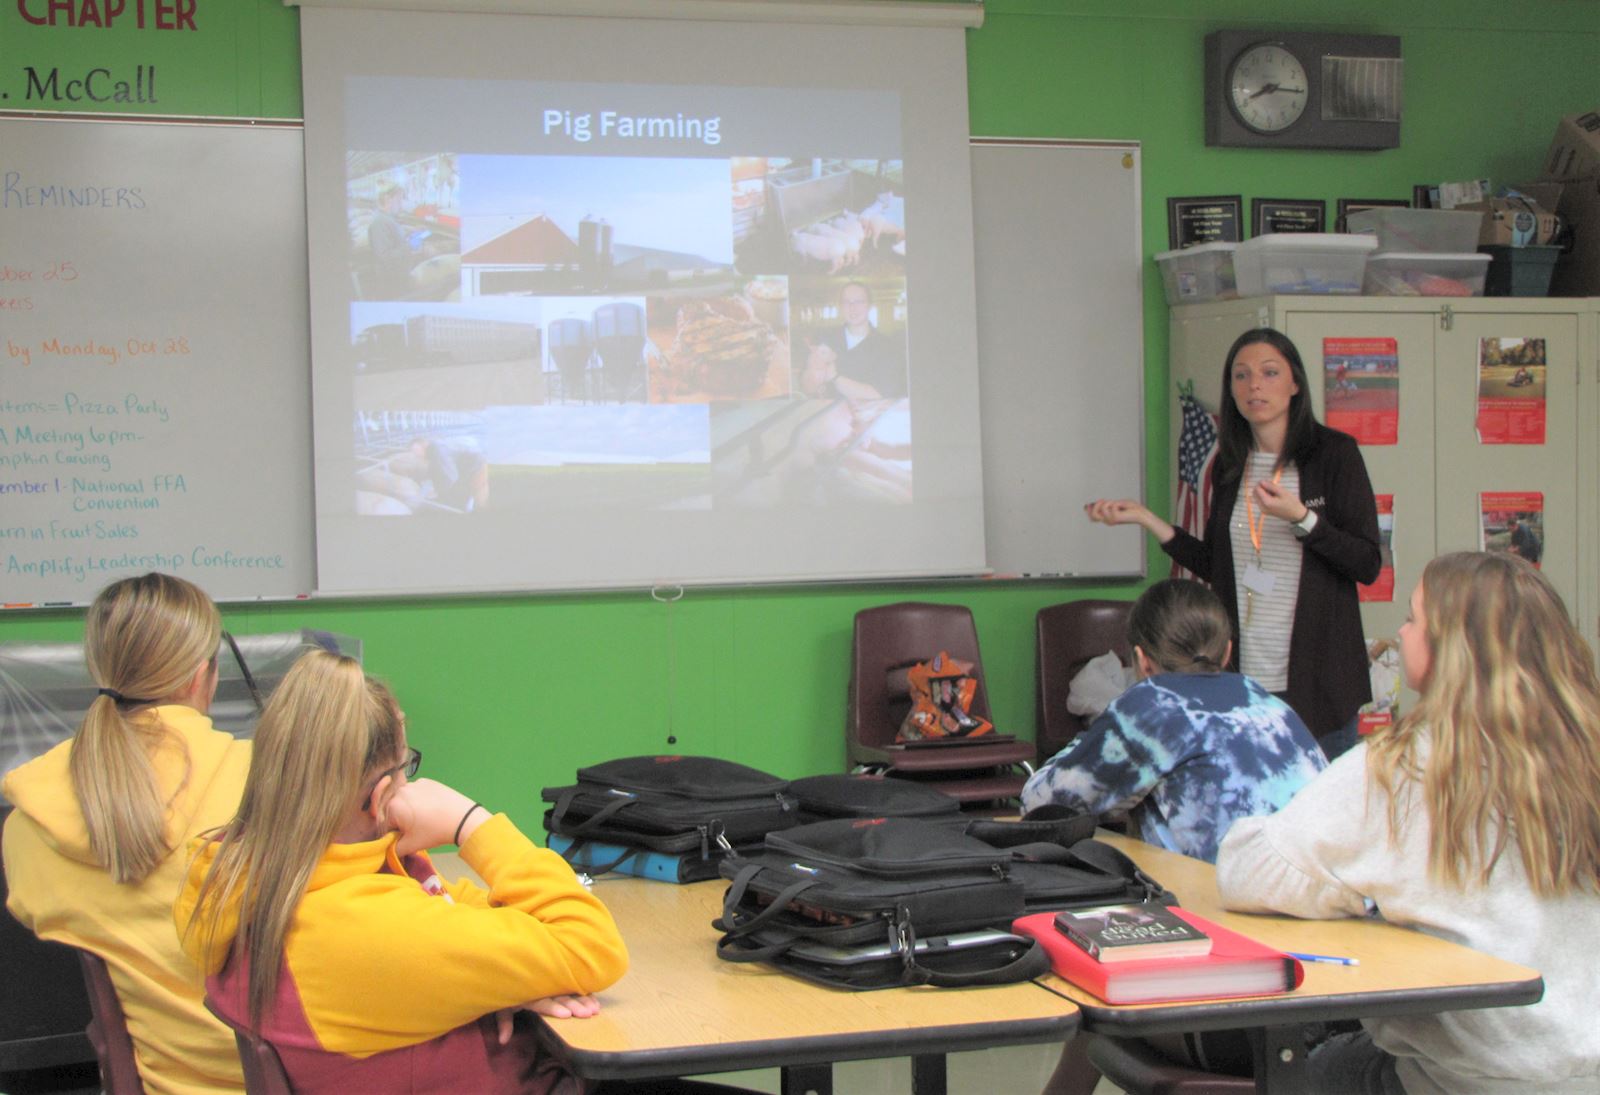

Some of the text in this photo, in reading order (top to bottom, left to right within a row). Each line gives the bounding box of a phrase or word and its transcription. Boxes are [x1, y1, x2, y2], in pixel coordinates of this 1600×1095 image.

[17, 0, 198, 31] CHAPTER
[23, 65, 158, 103] McCall
[543, 109, 722, 145] Pig Farming
[4, 170, 147, 209] REMINDERS
[42, 258, 79, 281] 25
[7, 339, 31, 366] by
[64, 391, 118, 415] Pizza
[16, 425, 85, 451] Meeting
[56, 449, 111, 472] Carving
[72, 477, 144, 494] National
[154, 474, 187, 493] FFA
[73, 496, 159, 512] Convention
[50, 520, 91, 539] Fruit
[95, 520, 138, 539] Sales
[7, 545, 284, 583] Amplify Leadership Conference
